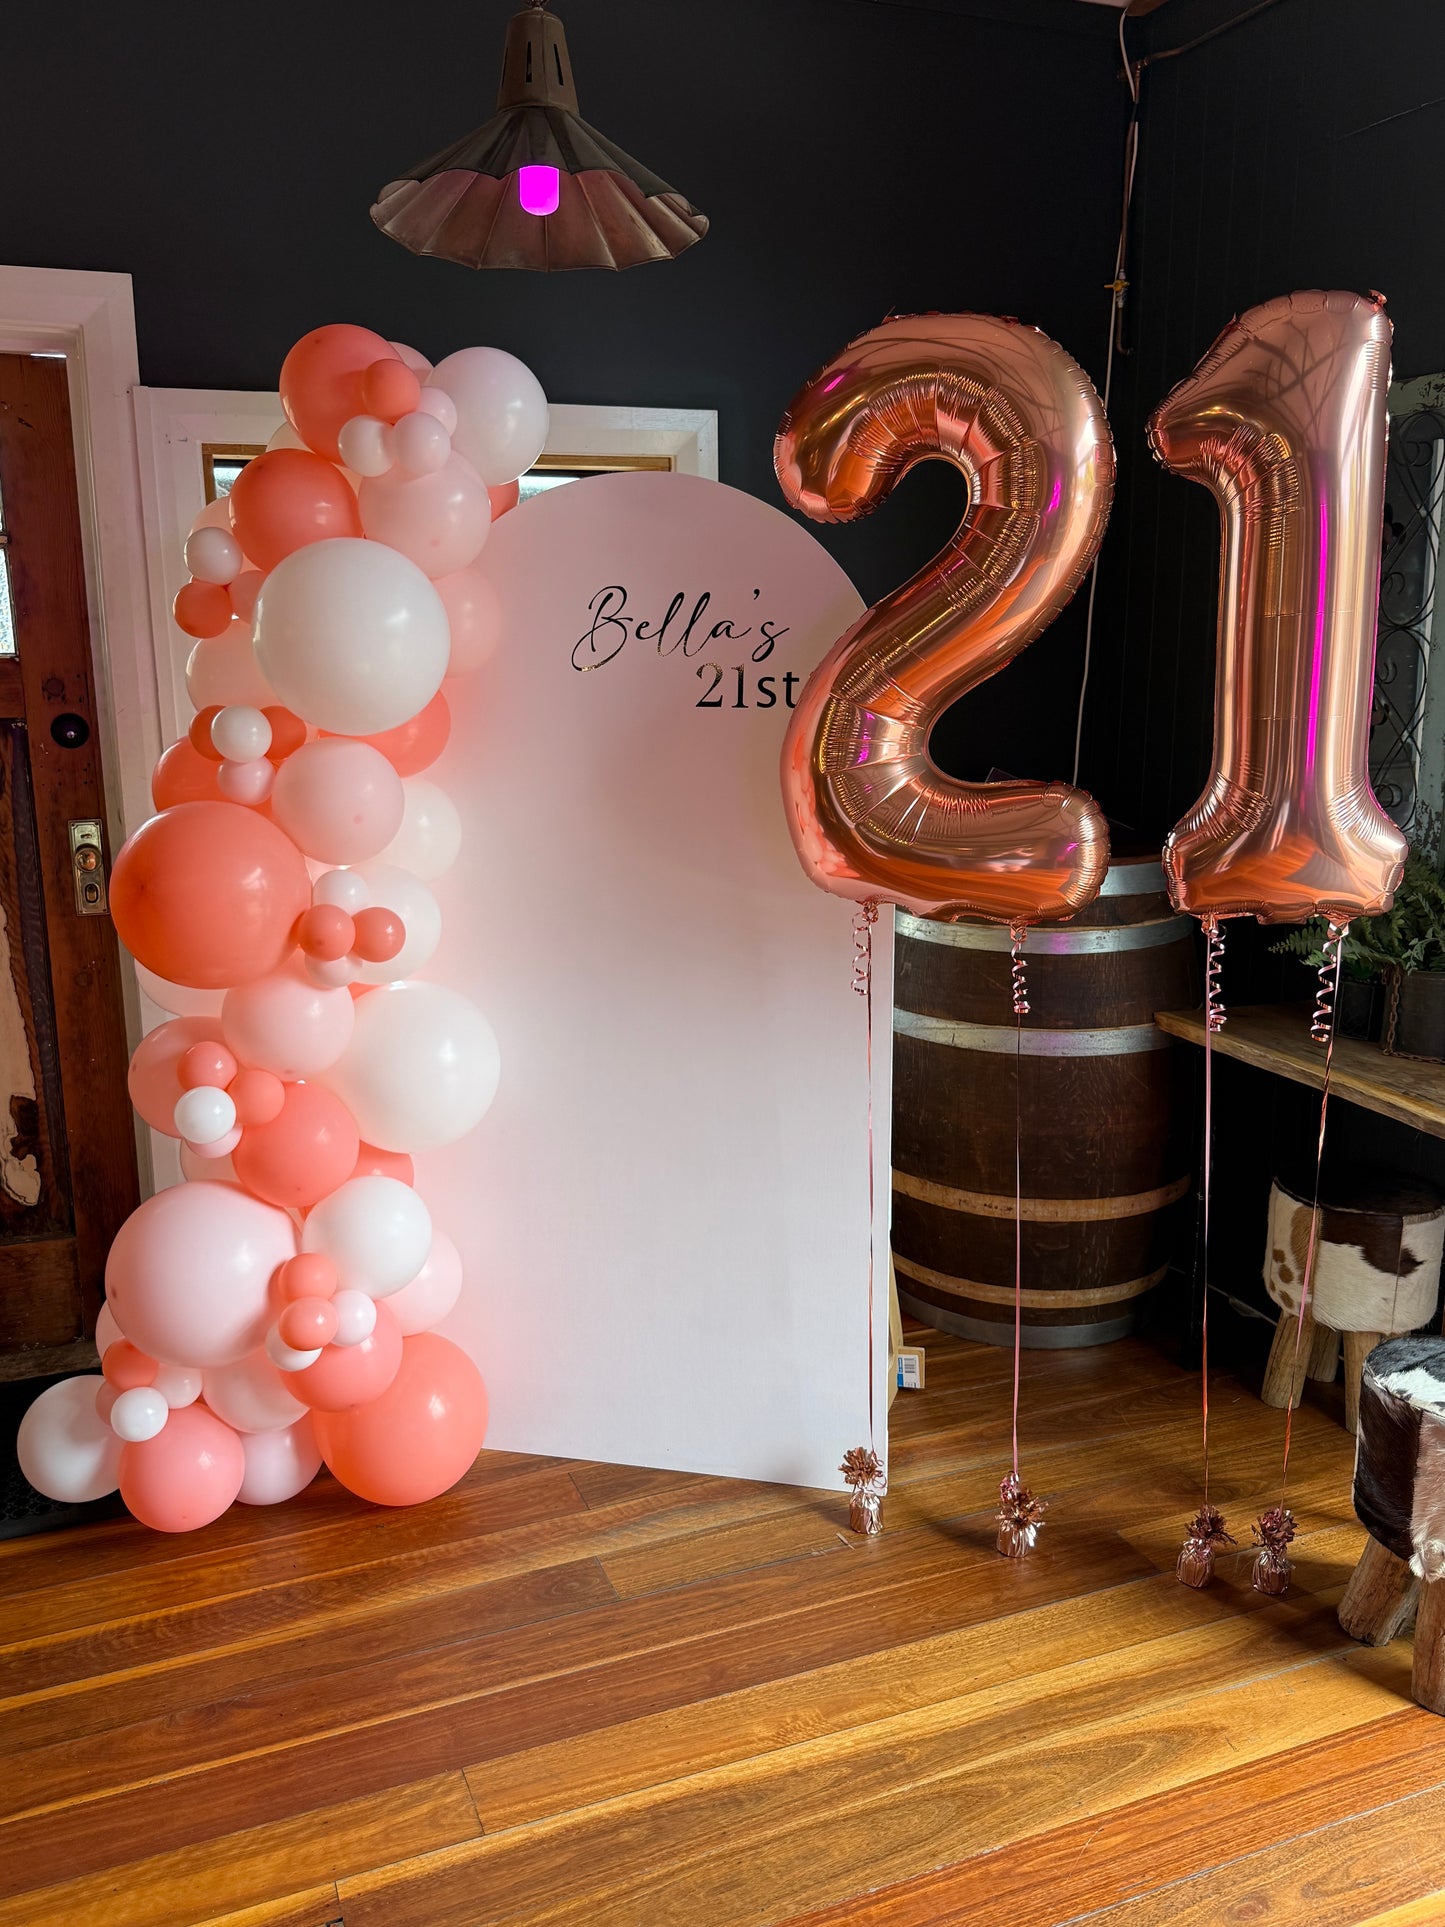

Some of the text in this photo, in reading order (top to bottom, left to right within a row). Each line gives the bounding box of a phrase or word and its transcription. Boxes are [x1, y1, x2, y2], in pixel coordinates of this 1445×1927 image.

[571, 585, 790, 672] Bella's
[773, 289, 1408, 925] 21
[695, 661, 800, 709] 21st
